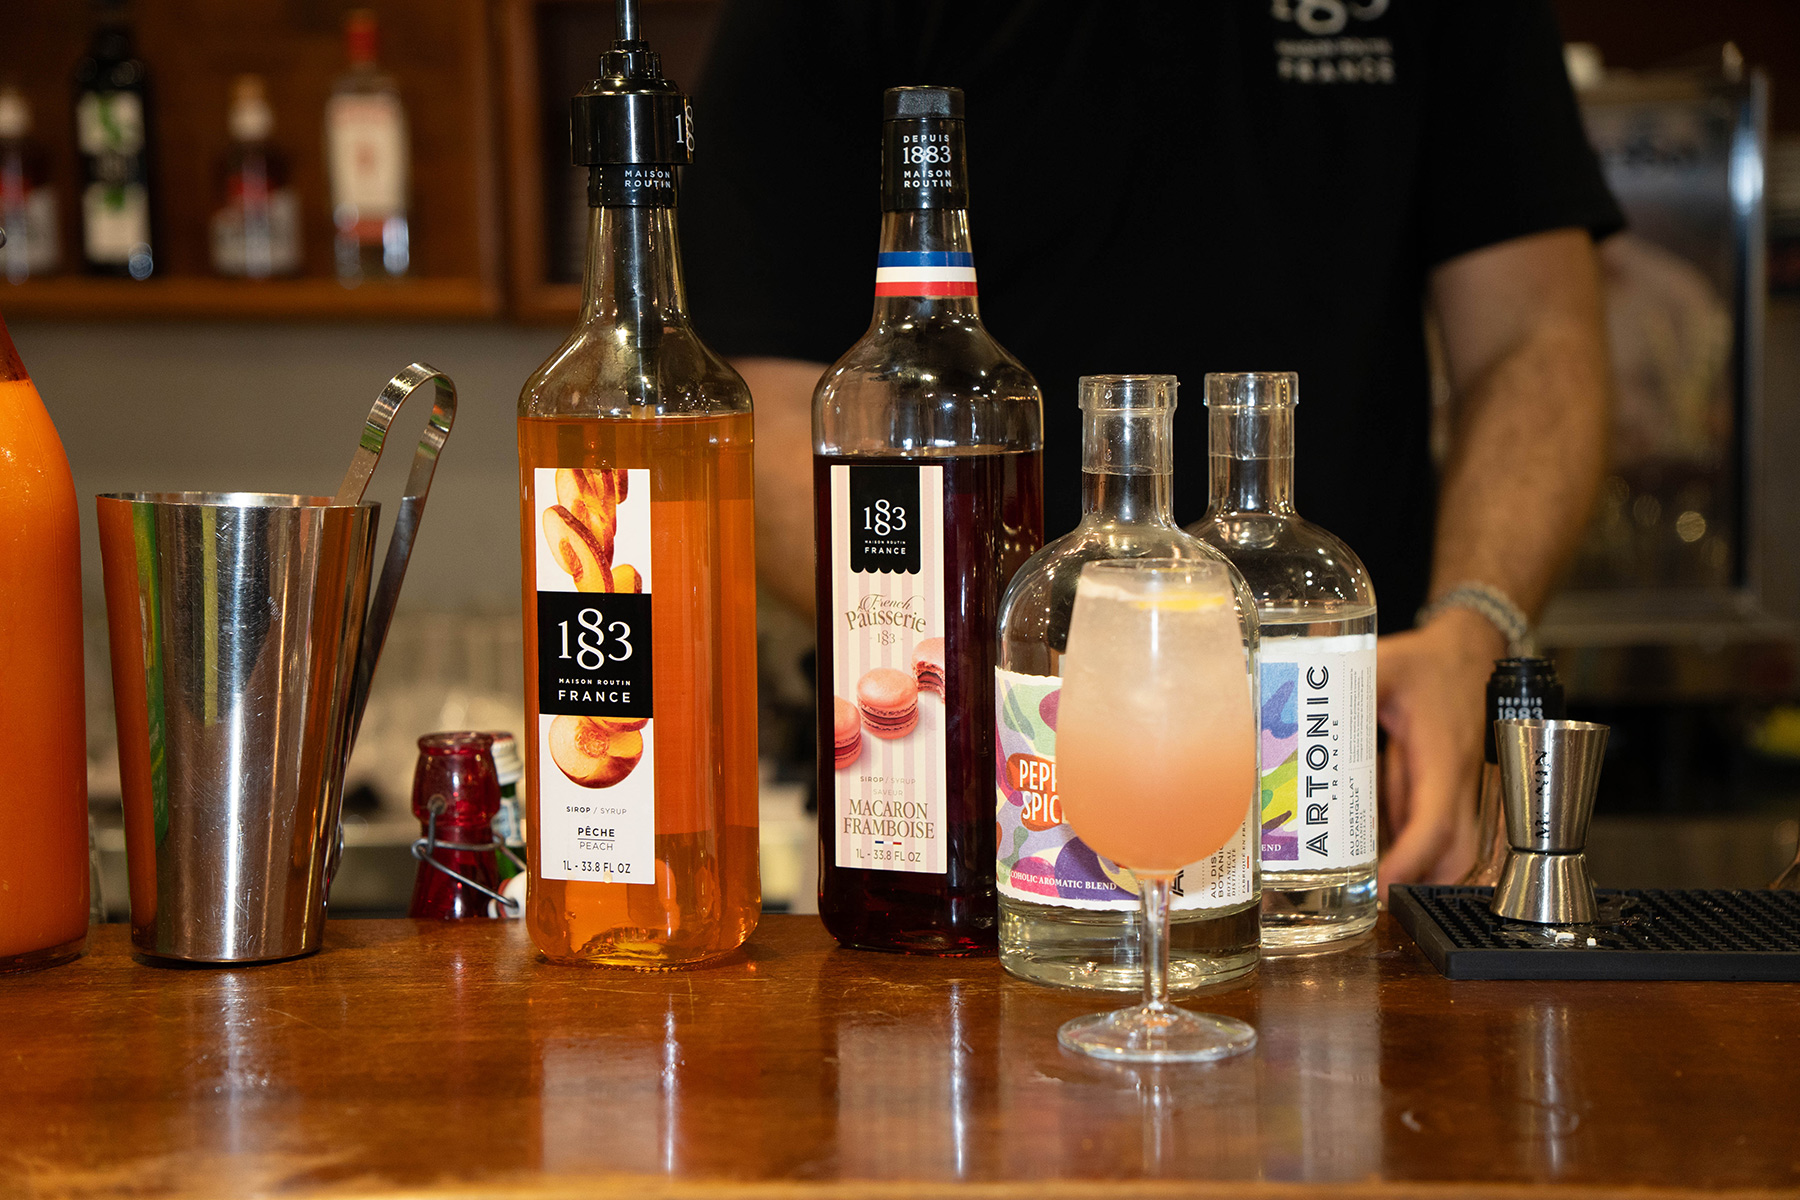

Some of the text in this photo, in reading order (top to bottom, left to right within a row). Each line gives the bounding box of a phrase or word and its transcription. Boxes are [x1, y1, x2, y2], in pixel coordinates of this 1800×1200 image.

[903, 134, 950, 143] DEPUIS
[903, 145, 951, 164] 1883
[624, 170, 671, 178] MAISON
[904, 170, 951, 178] MAISON
[624, 180, 671, 188] ROUTIN
[904, 180, 952, 188] ROUTIN
[864, 546, 907, 555] FRANCE
[860, 593, 925, 610] French
[844, 605, 926, 633] Pâtisserie
[558, 690, 631, 703] FRANCE
[1498, 696, 1543, 707] DEPUIS
[1306, 666, 1329, 857] ARTONIC
[1020, 759, 1057, 792] PEP
[566, 805, 591, 813] SIROP
[600, 807, 627, 815] SYRUP
[849, 798, 928, 819] MACARON
[577, 825, 615, 837] PÊCHE
[843, 817, 935, 839] FRAMBOISE
[579, 841, 614, 851] PEACH
[1349, 841, 1355, 857] AU
[856, 848, 864, 858] 1L
[873, 849, 892, 860] 33.8
[894, 851, 905, 861] FL
[908, 851, 921, 862] OZ
[563, 860, 572, 871] 1L
[581, 860, 600, 873] 33.8
[603, 862, 614, 873] FL
[617, 863, 631, 874] OZ
[1038, 876, 1083, 889] AROMATIC
[1085, 881, 1117, 890] BLEND
[1210, 882, 1217, 898] AU
